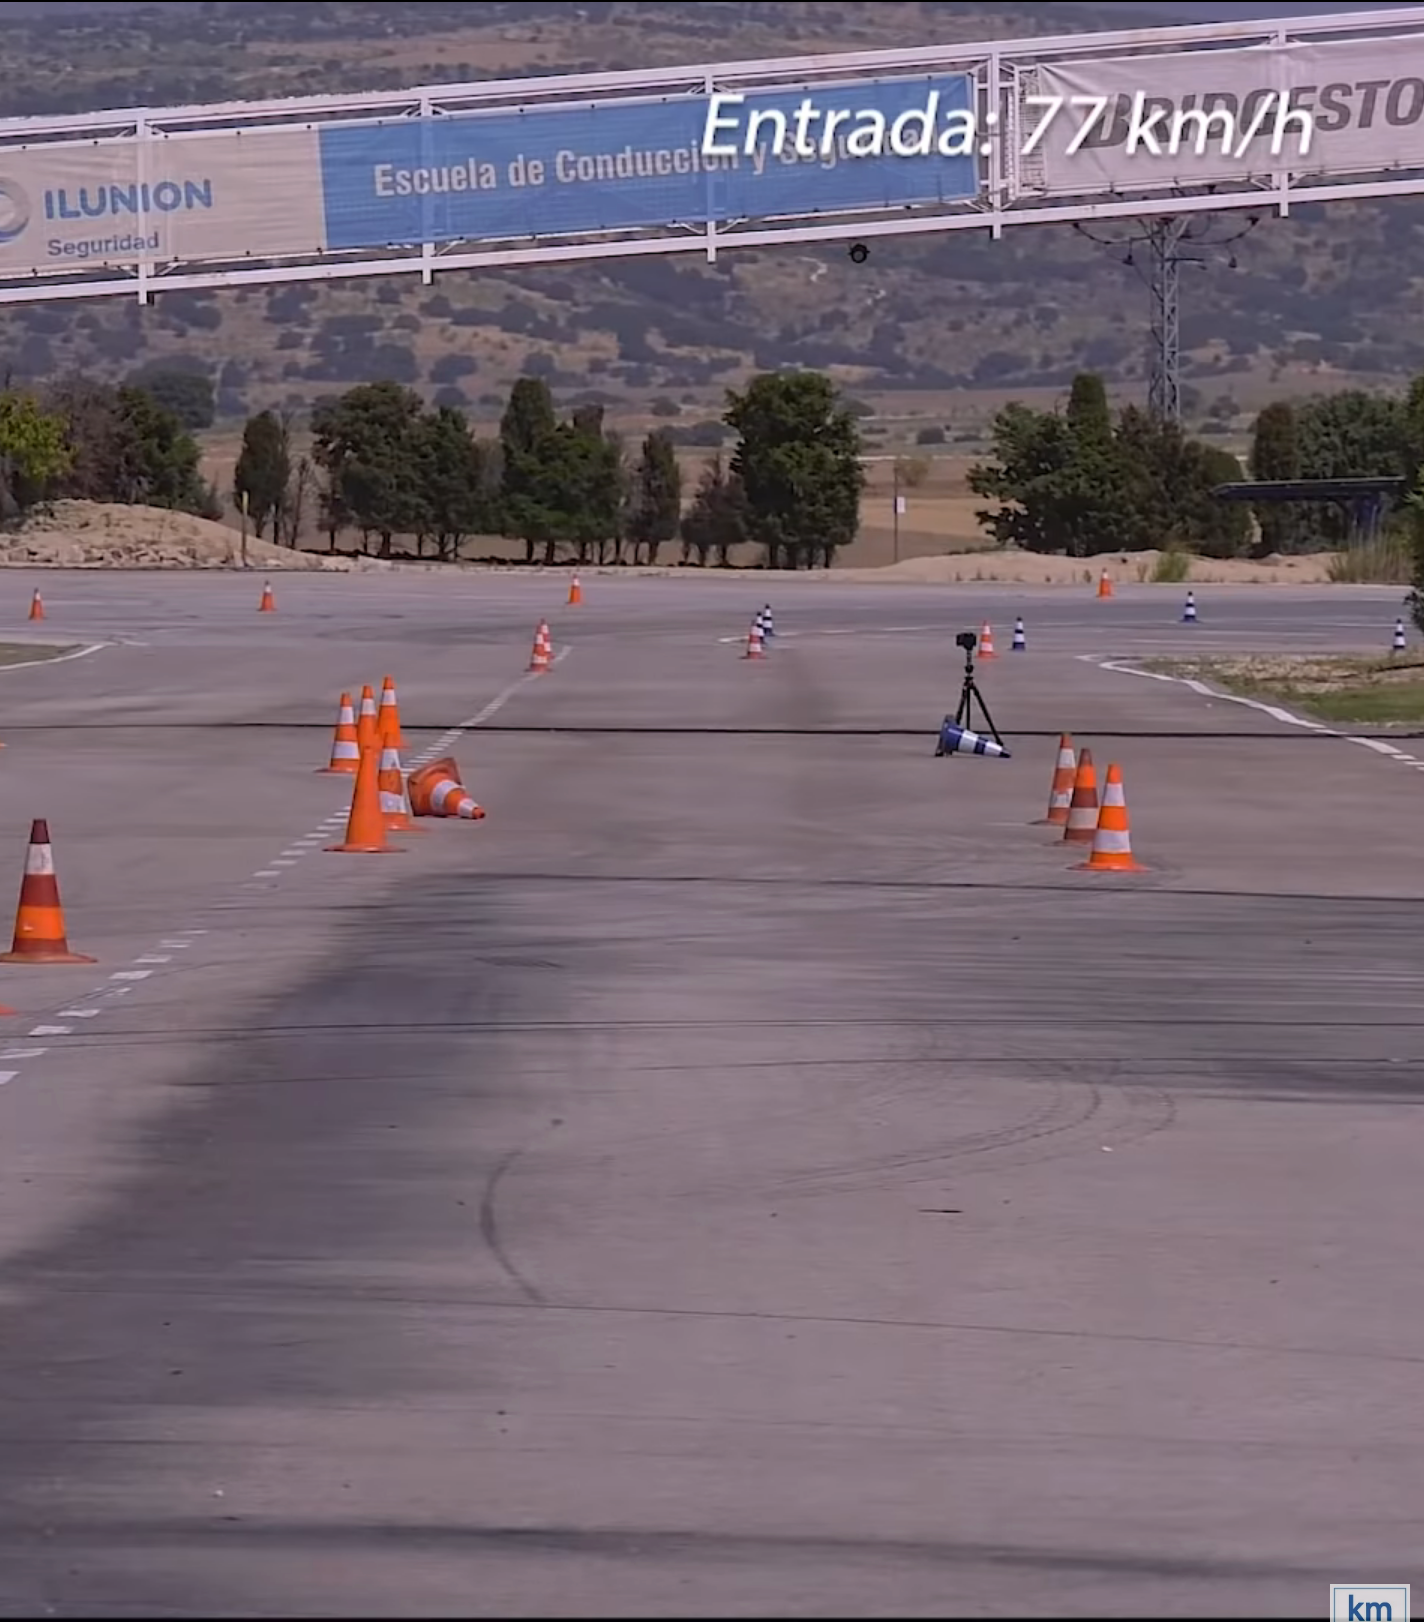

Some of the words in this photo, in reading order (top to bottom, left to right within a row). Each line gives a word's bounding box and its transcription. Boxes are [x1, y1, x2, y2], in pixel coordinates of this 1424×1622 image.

[1078, 77, 1424, 149] BRIDGESTO
[374, 157, 496, 197] Escuela
[508, 154, 544, 188] de
[44, 179, 213, 220] ILUNION
[47, 231, 159, 258] Seguridad
